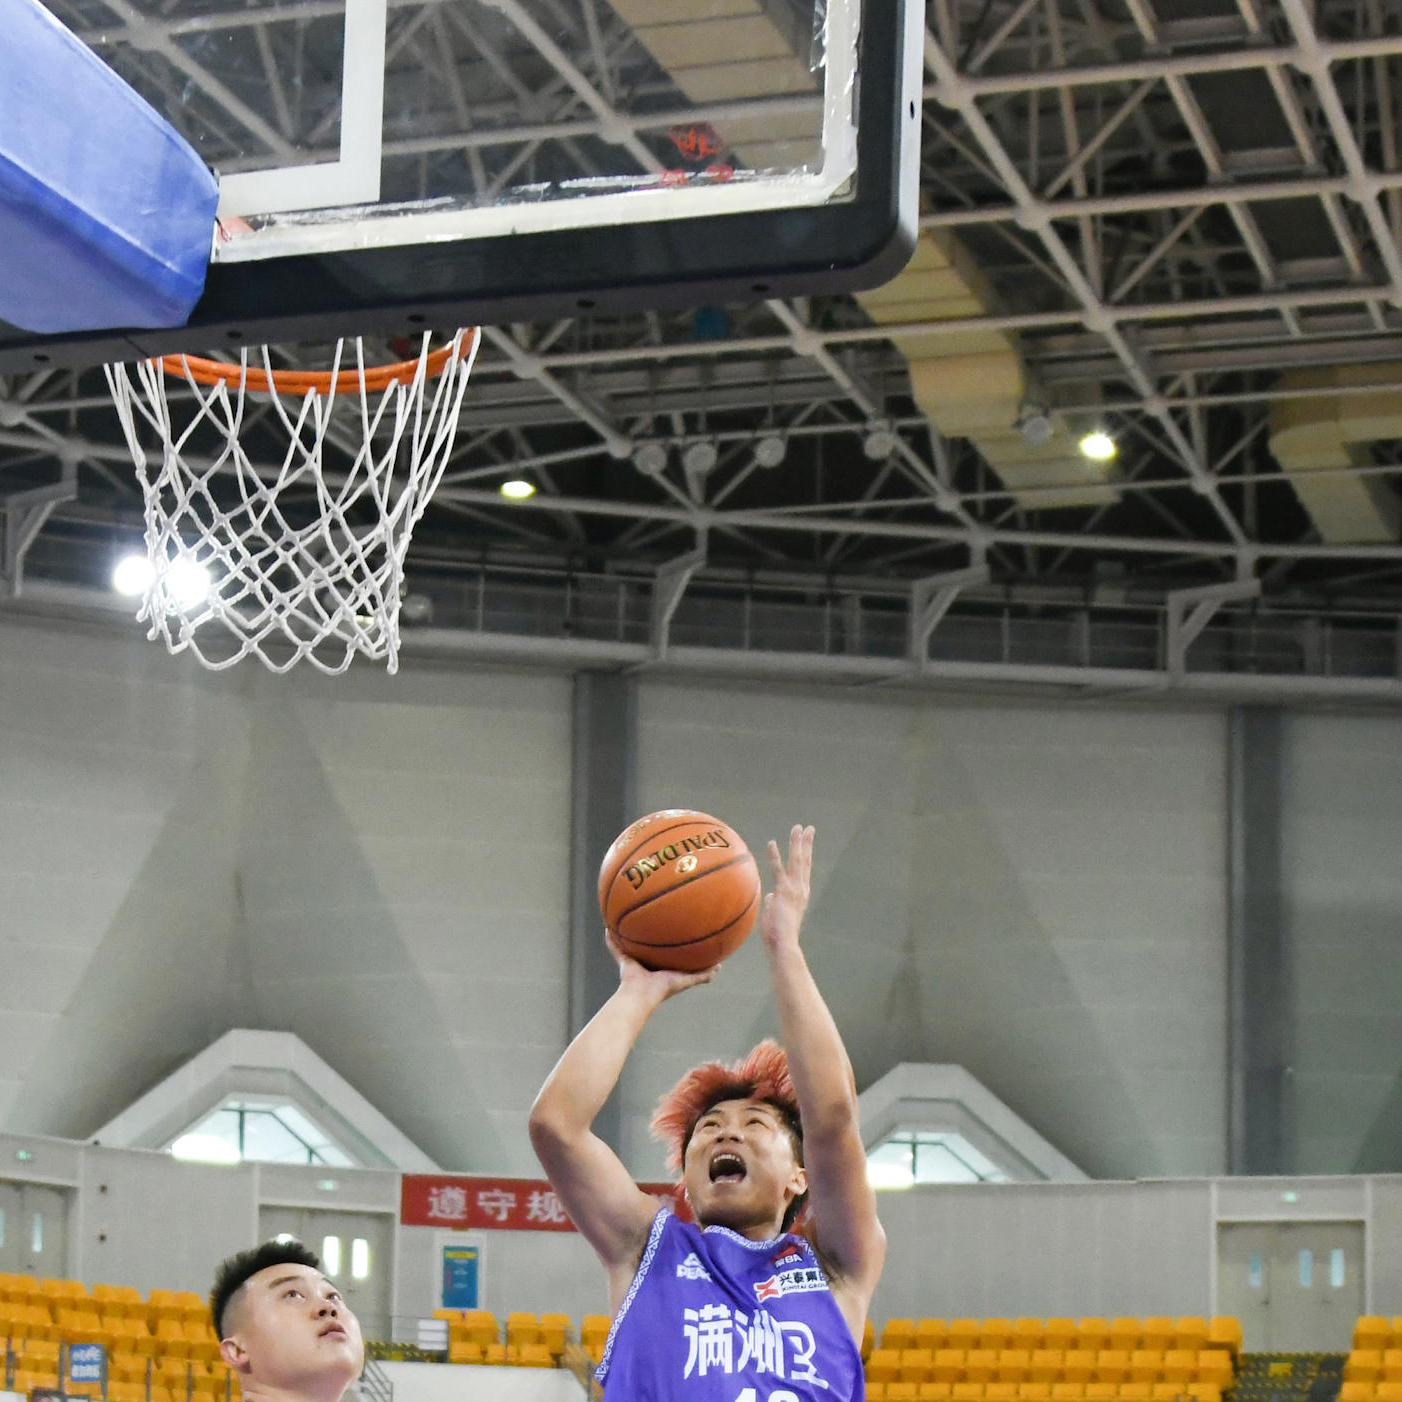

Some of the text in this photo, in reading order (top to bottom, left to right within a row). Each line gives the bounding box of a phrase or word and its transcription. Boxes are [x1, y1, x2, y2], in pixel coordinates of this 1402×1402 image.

[624, 830, 729, 889] SPALDING
[683, 1303, 830, 1390] 满洲里
